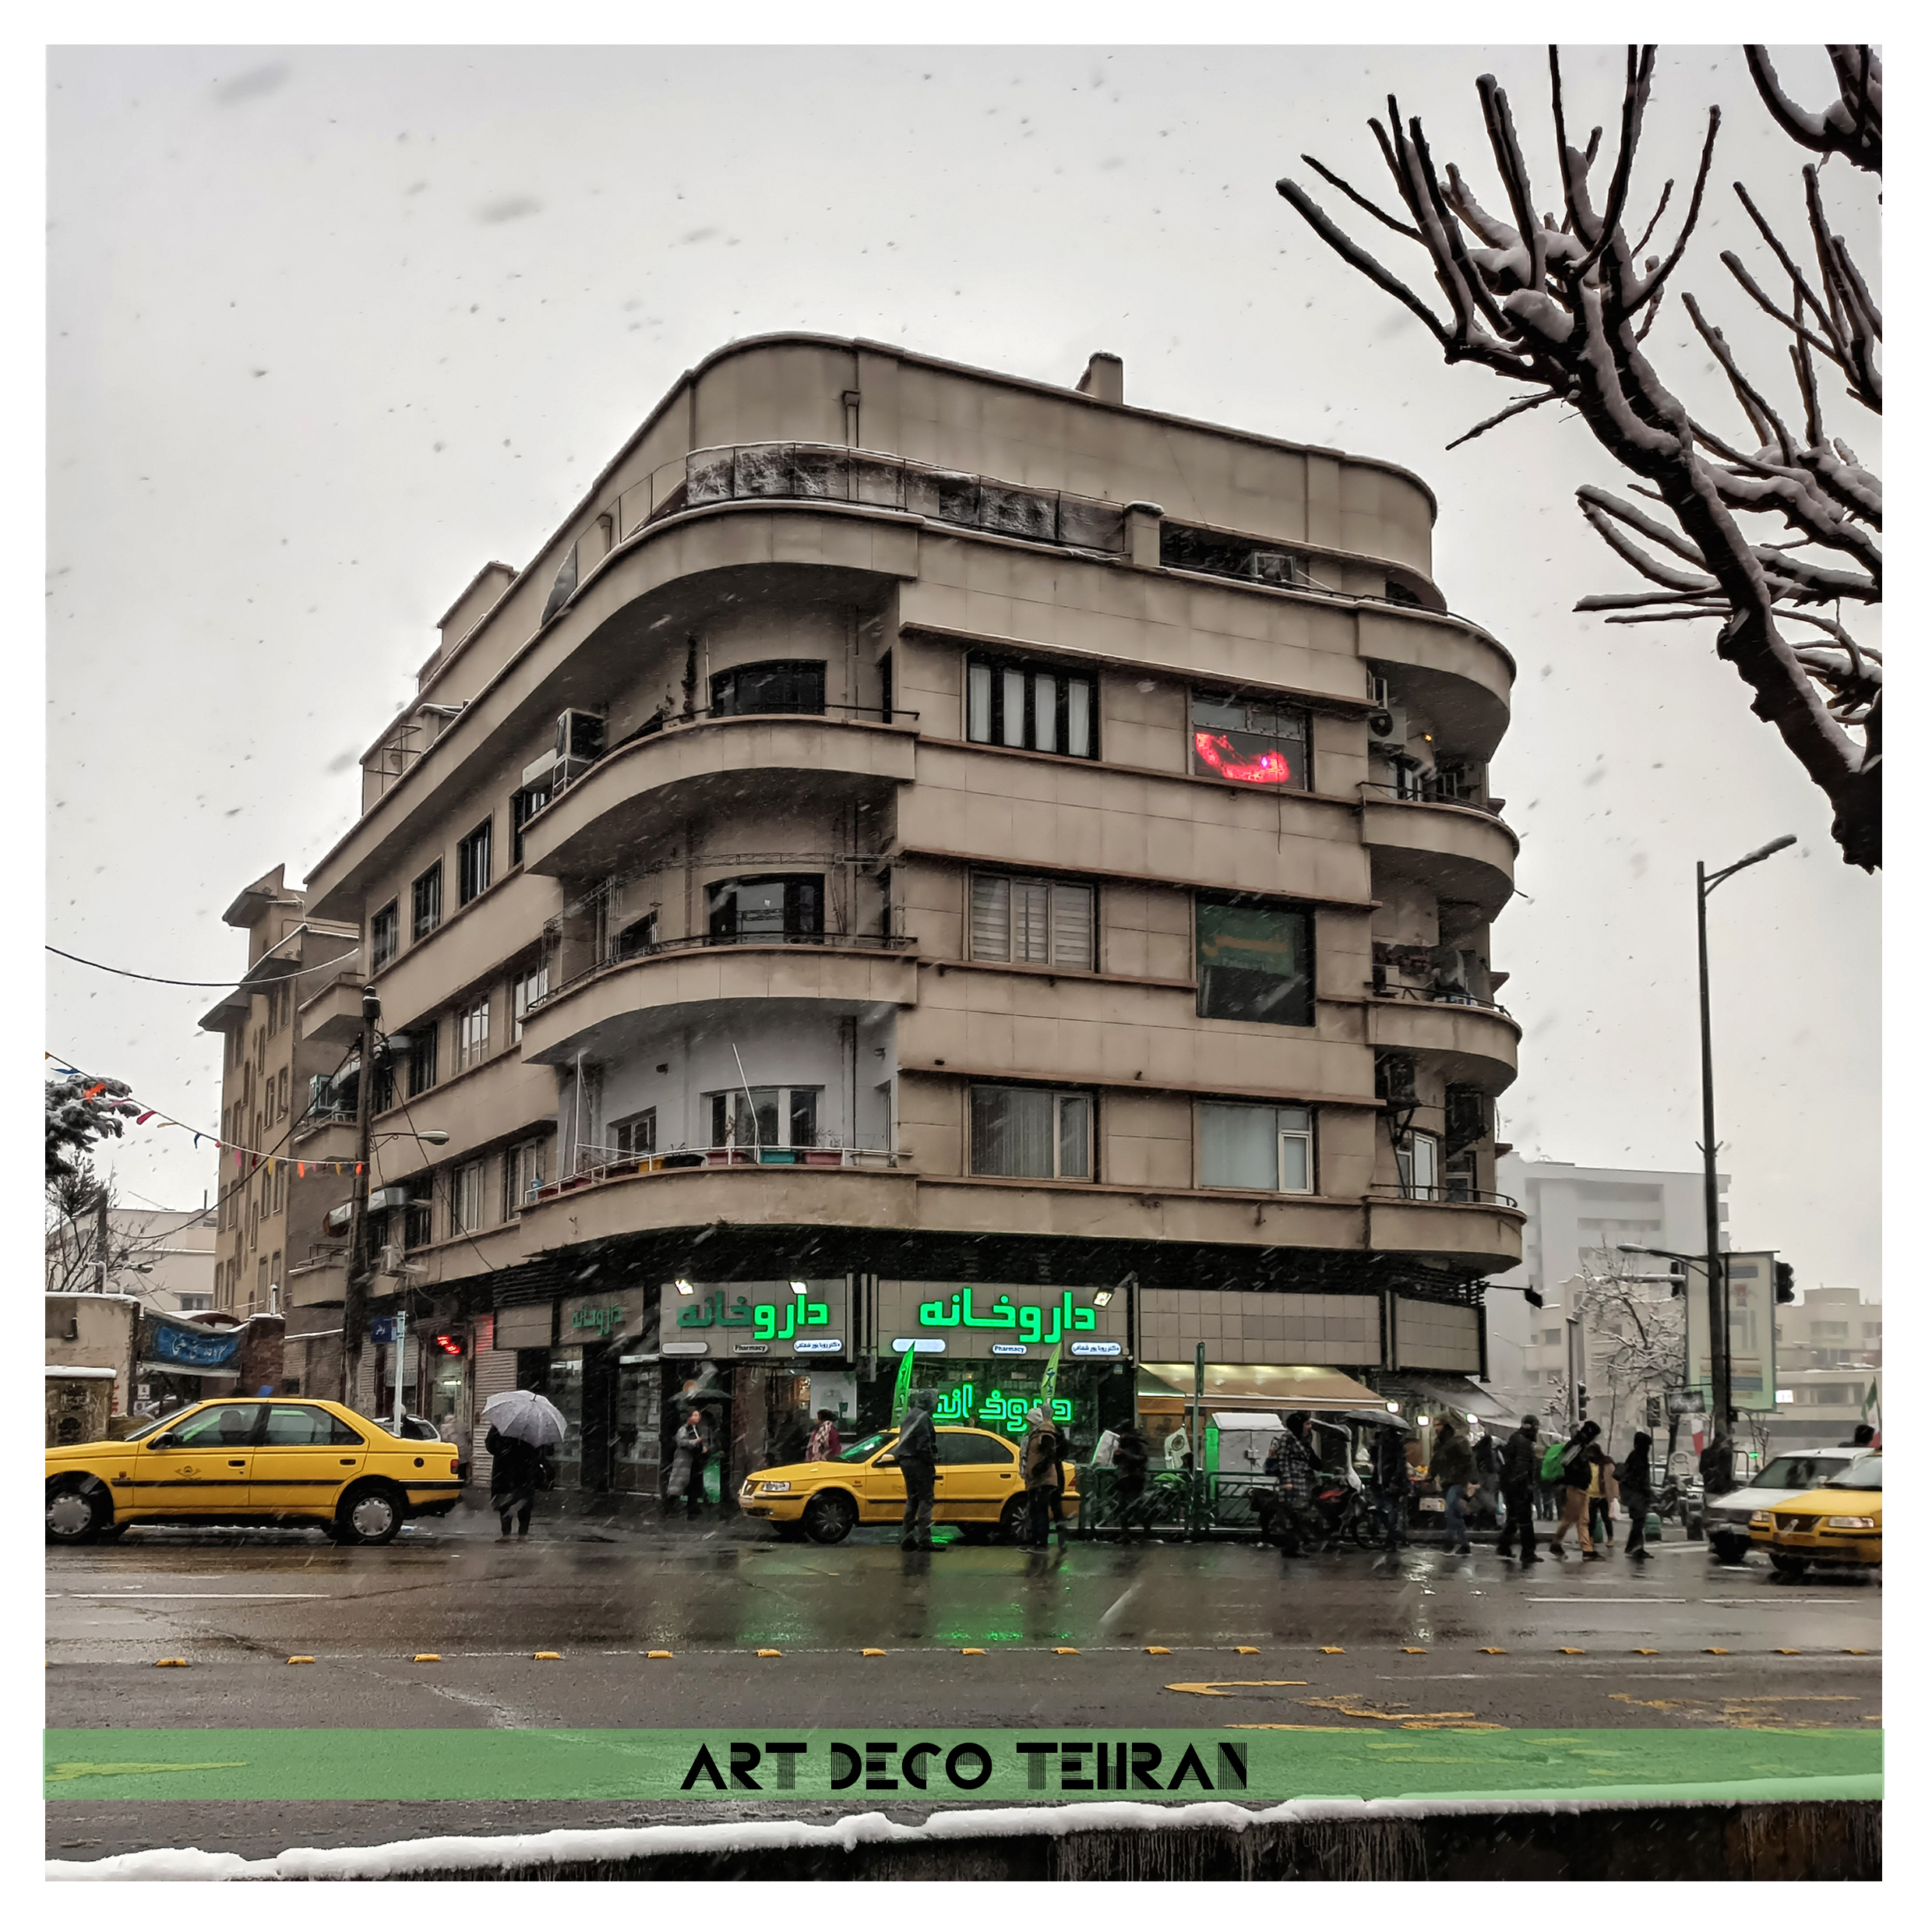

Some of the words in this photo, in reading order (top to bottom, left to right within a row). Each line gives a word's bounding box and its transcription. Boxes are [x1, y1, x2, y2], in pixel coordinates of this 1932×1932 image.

[572, 1305, 622, 1336] داروخانه
[676, 1292, 830, 1339] داروخانه
[919, 1287, 1096, 1344] داروخانه
[933, 1384, 1072, 1432] دوخانه
